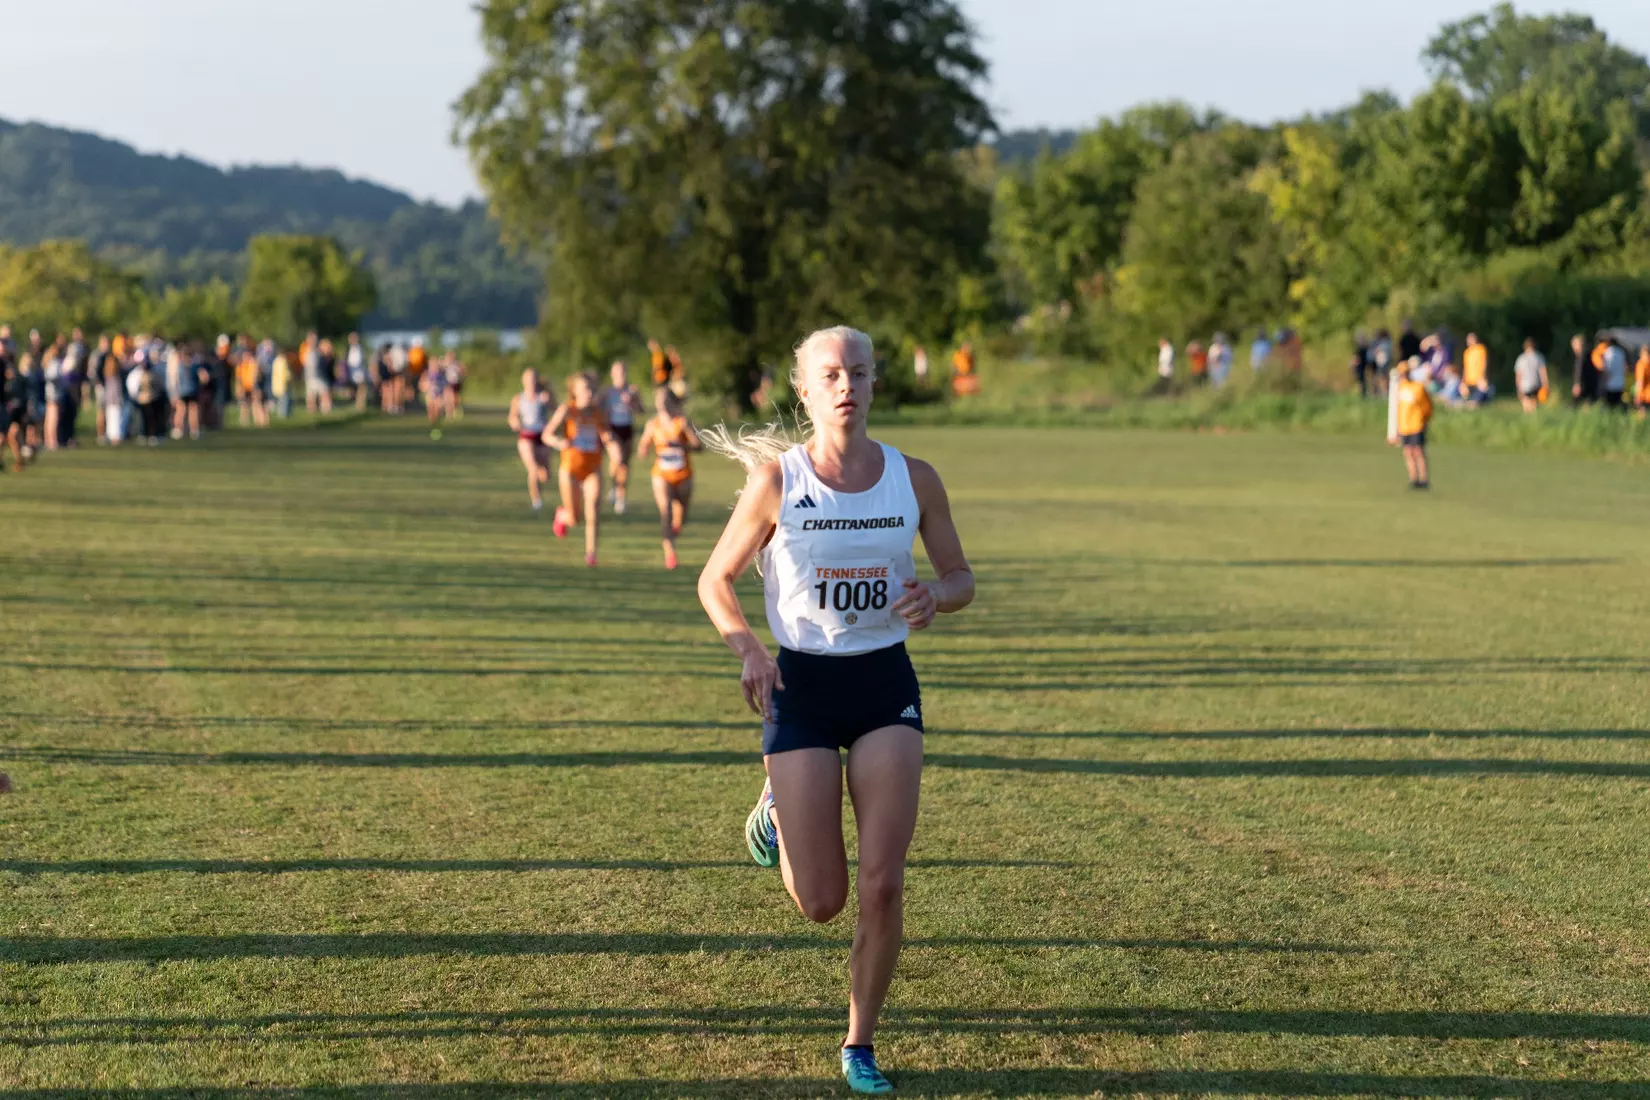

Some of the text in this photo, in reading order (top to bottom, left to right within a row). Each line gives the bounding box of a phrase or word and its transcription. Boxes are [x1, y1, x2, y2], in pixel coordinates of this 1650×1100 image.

[802, 516, 905, 531] CHATTANOOGA
[815, 567, 888, 579] TENNESSEE
[814, 580, 888, 611] 1008
